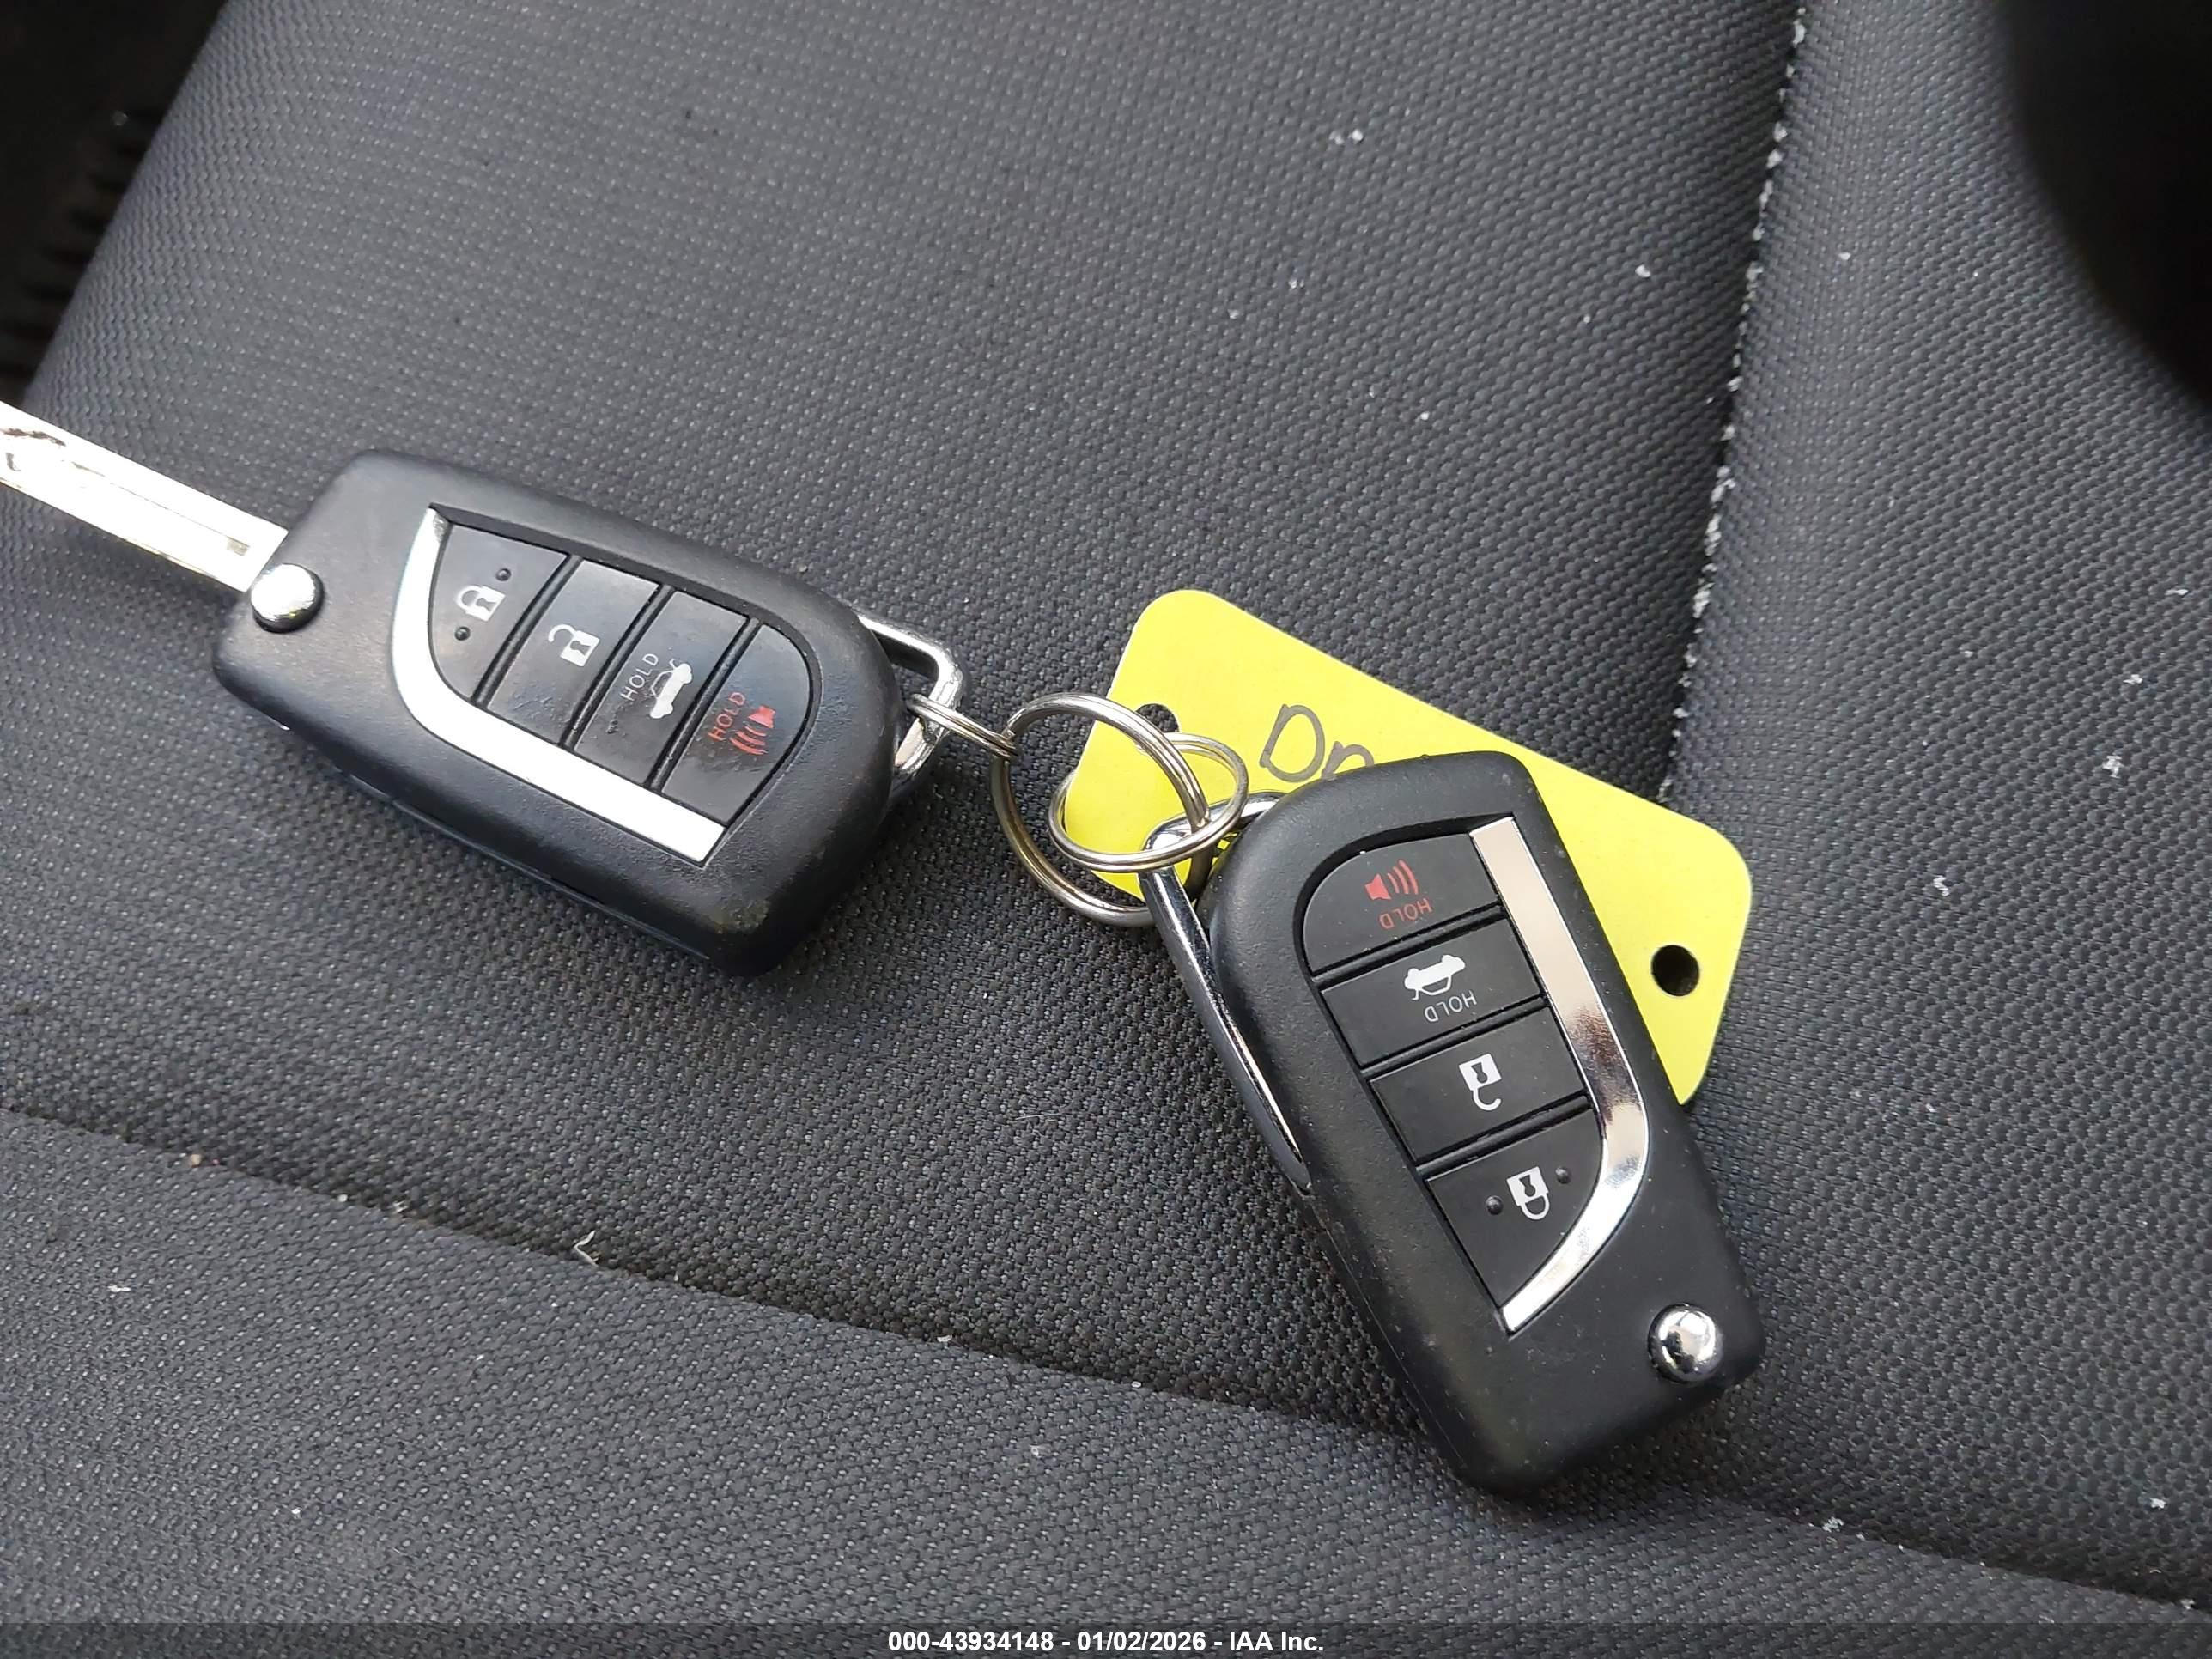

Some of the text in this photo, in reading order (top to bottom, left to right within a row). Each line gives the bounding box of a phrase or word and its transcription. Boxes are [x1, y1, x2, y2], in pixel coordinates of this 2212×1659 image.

[619, 653, 659, 702] HOLD
[708, 691, 746, 741] HOLD
[1378, 898, 1433, 929] HOLD
[1424, 989, 1478, 1022] HOLD
